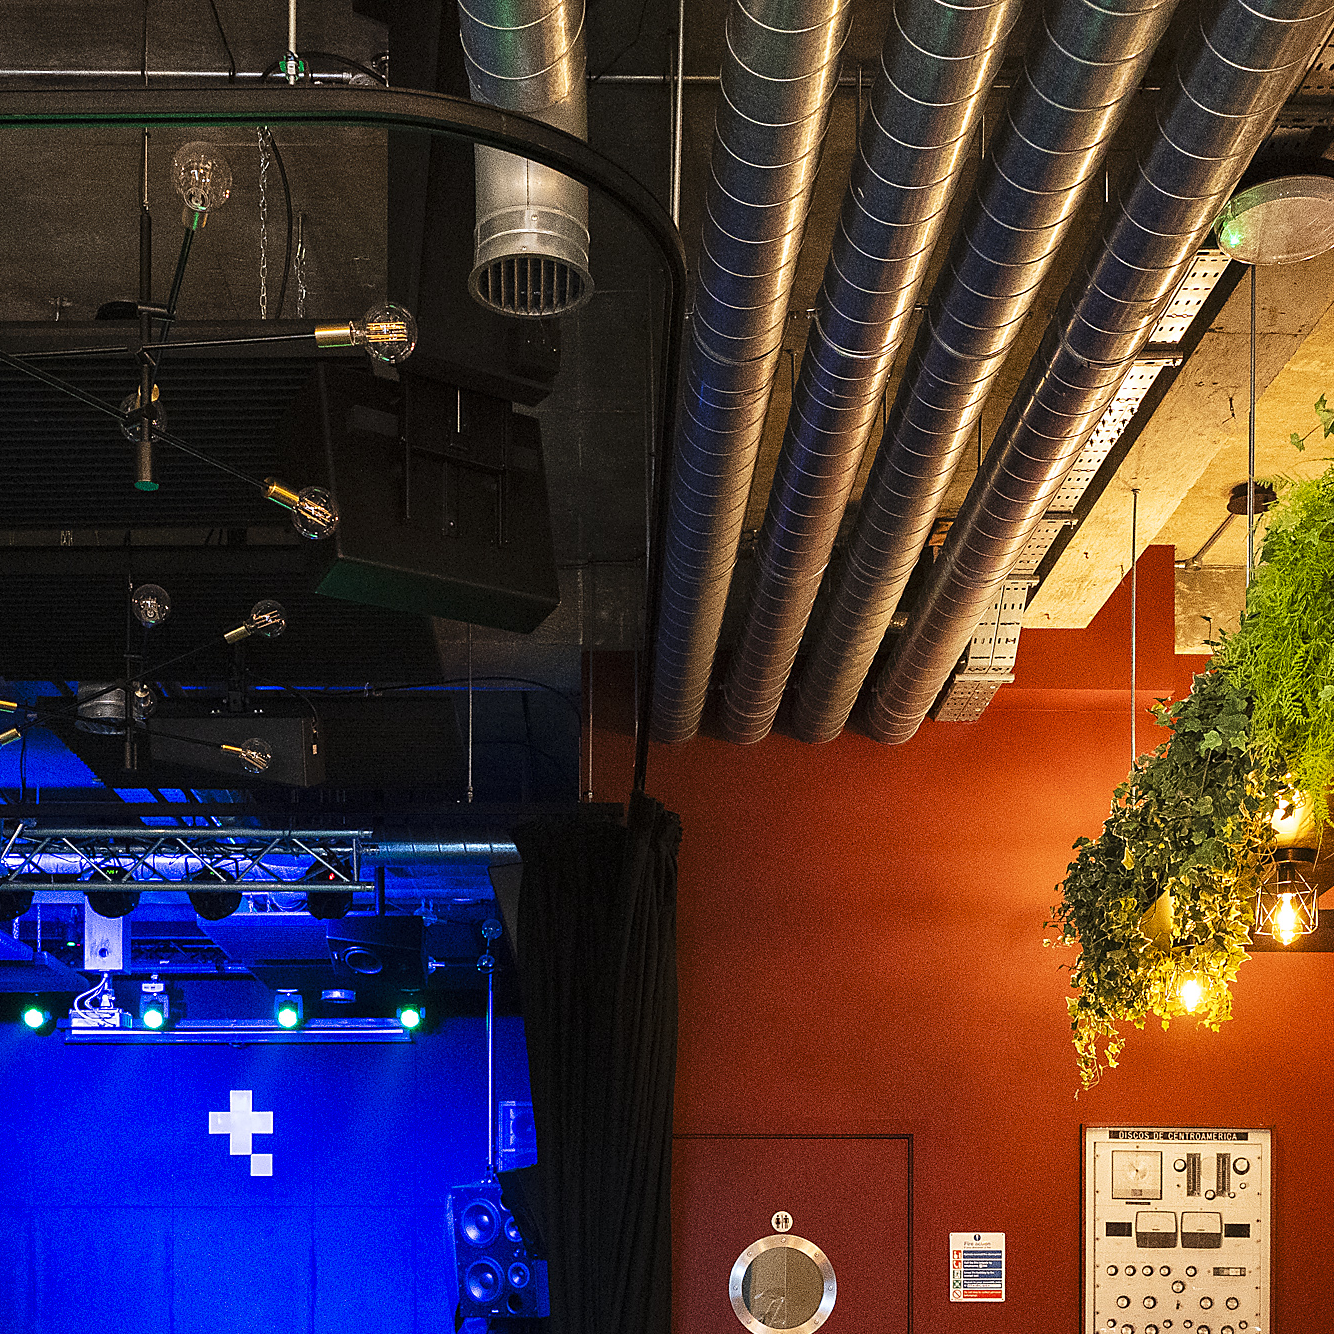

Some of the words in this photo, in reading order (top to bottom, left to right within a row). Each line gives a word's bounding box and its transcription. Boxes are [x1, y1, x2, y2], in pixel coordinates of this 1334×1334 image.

[1118, 1131, 1150, 1140] DISCOS
[1153, 1131, 1164, 1140] DE
[1168, 1131, 1238, 1141] CENTROAMERICA
